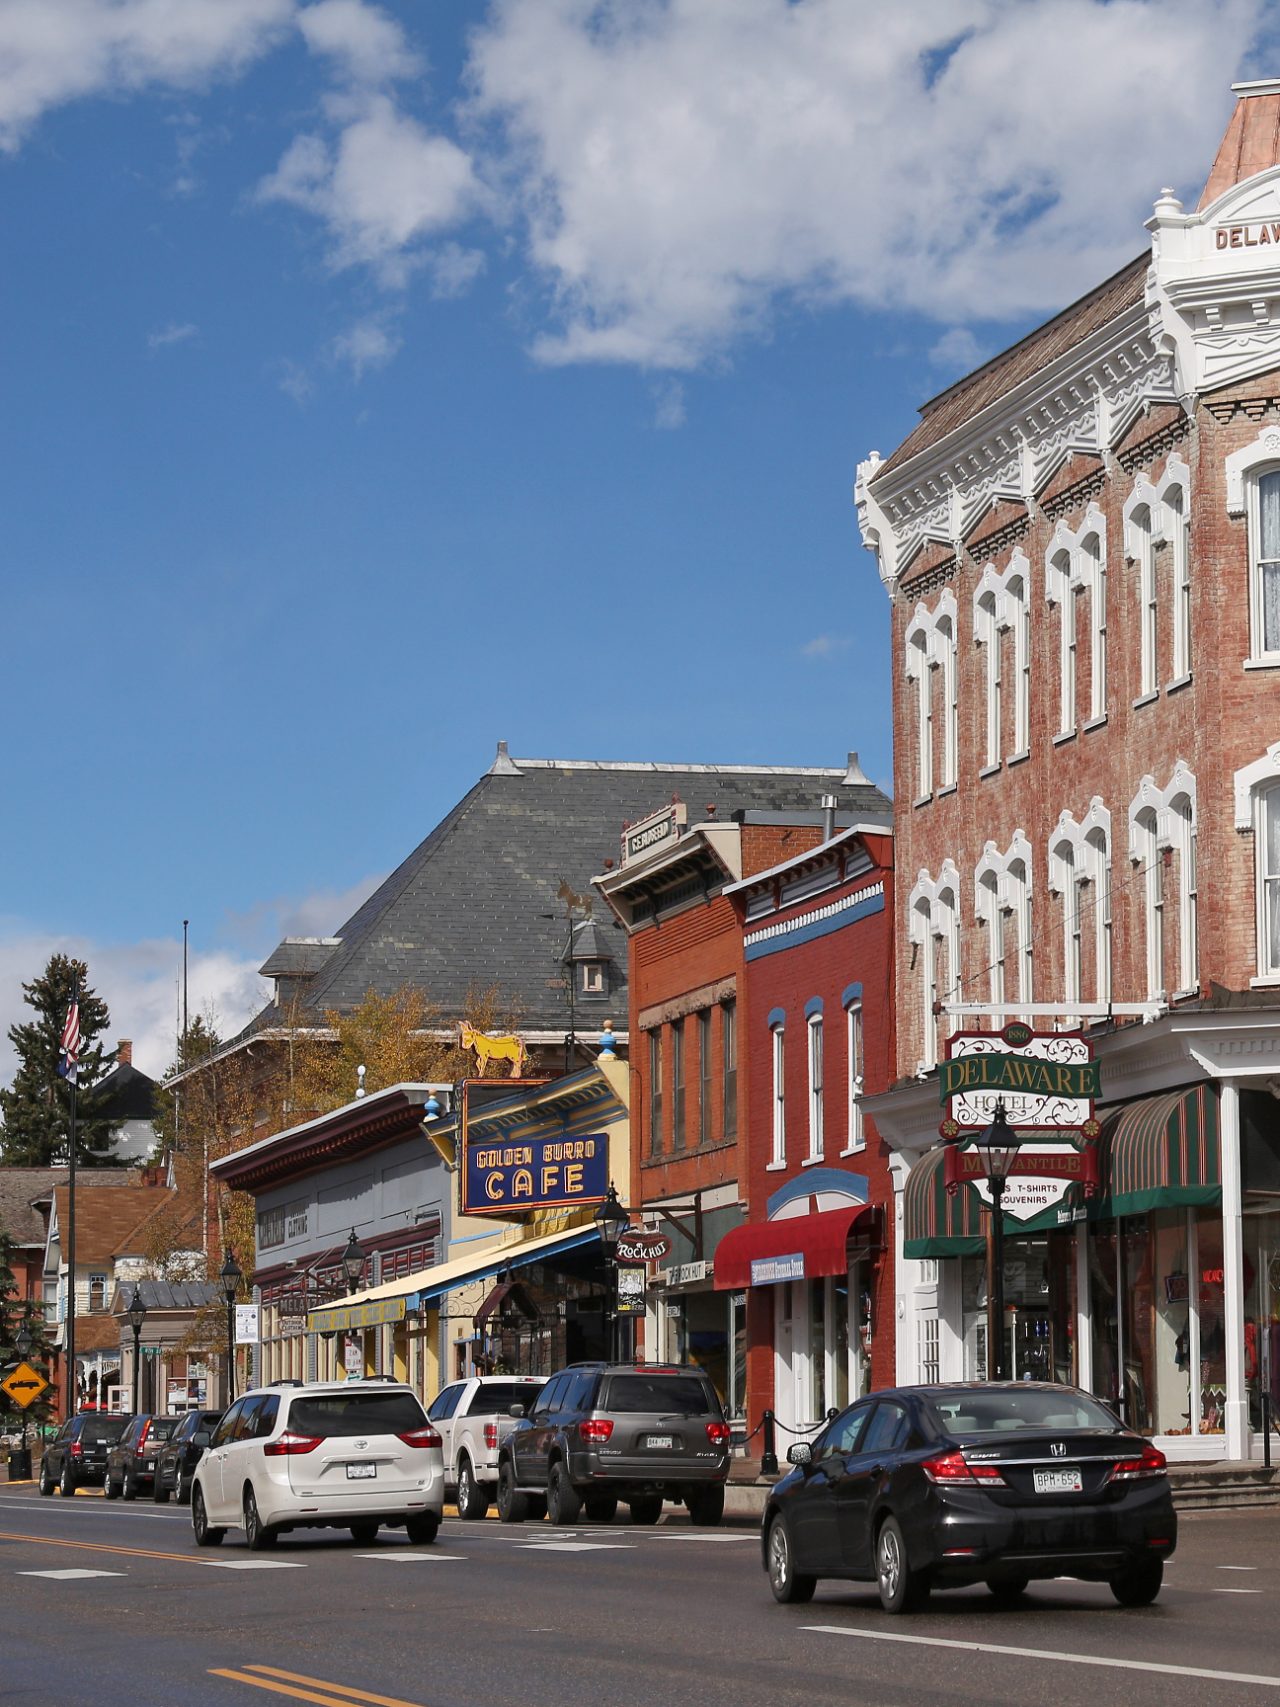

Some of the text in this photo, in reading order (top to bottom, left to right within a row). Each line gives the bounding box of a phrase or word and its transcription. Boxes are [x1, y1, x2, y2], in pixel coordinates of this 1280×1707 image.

[945, 1057, 1096, 1094] DELAWARE
[973, 1095, 1033, 1110] HOTEL
[476, 1139, 595, 1168] GOLDEN BURRO
[962, 1155, 1081, 1173] MANTILE
[484, 1163, 584, 1201] CAFE
[1017, 1184, 1058, 1193] T-SHIRTS
[999, 1195, 1048, 1204] SOUVENIRS
[617, 1240, 667, 1259] ROCK HUT
[691, 1264, 702, 1280] HUT
